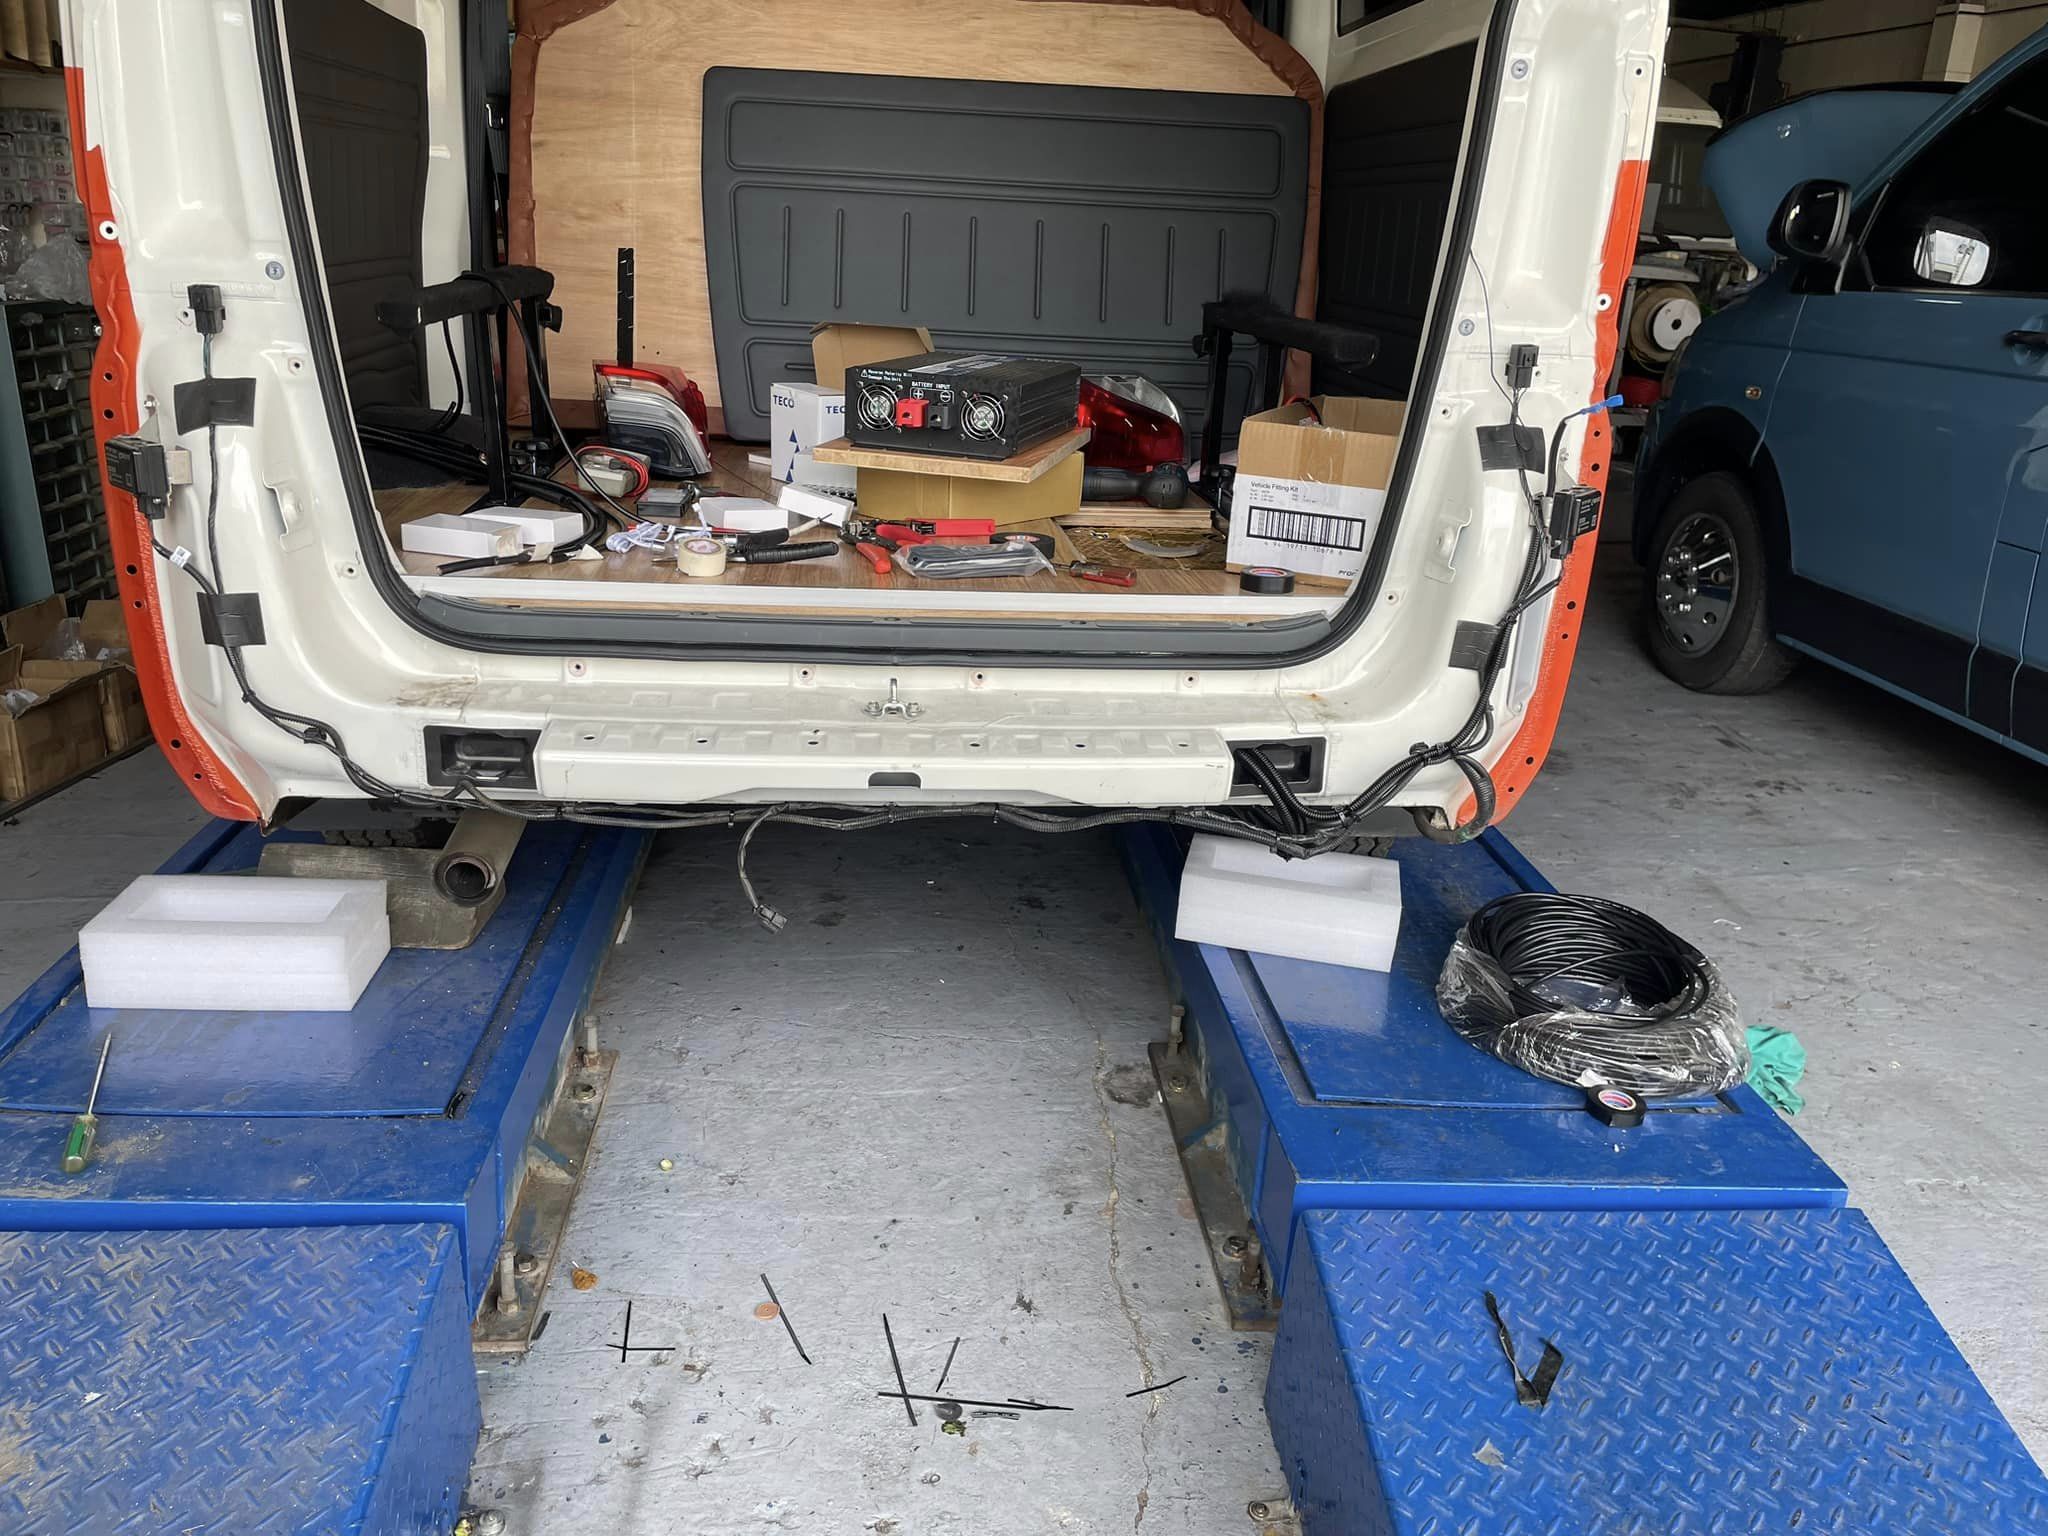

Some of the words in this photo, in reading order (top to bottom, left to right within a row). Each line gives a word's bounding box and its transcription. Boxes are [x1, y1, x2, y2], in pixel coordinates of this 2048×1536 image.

[911, 381, 933, 389] BATTERY
[773, 394, 795, 409] TECO
[825, 406, 846, 414] TEC
[1251, 481, 1271, 489] Vehicle
[1271, 484, 1289, 493] Fitting
